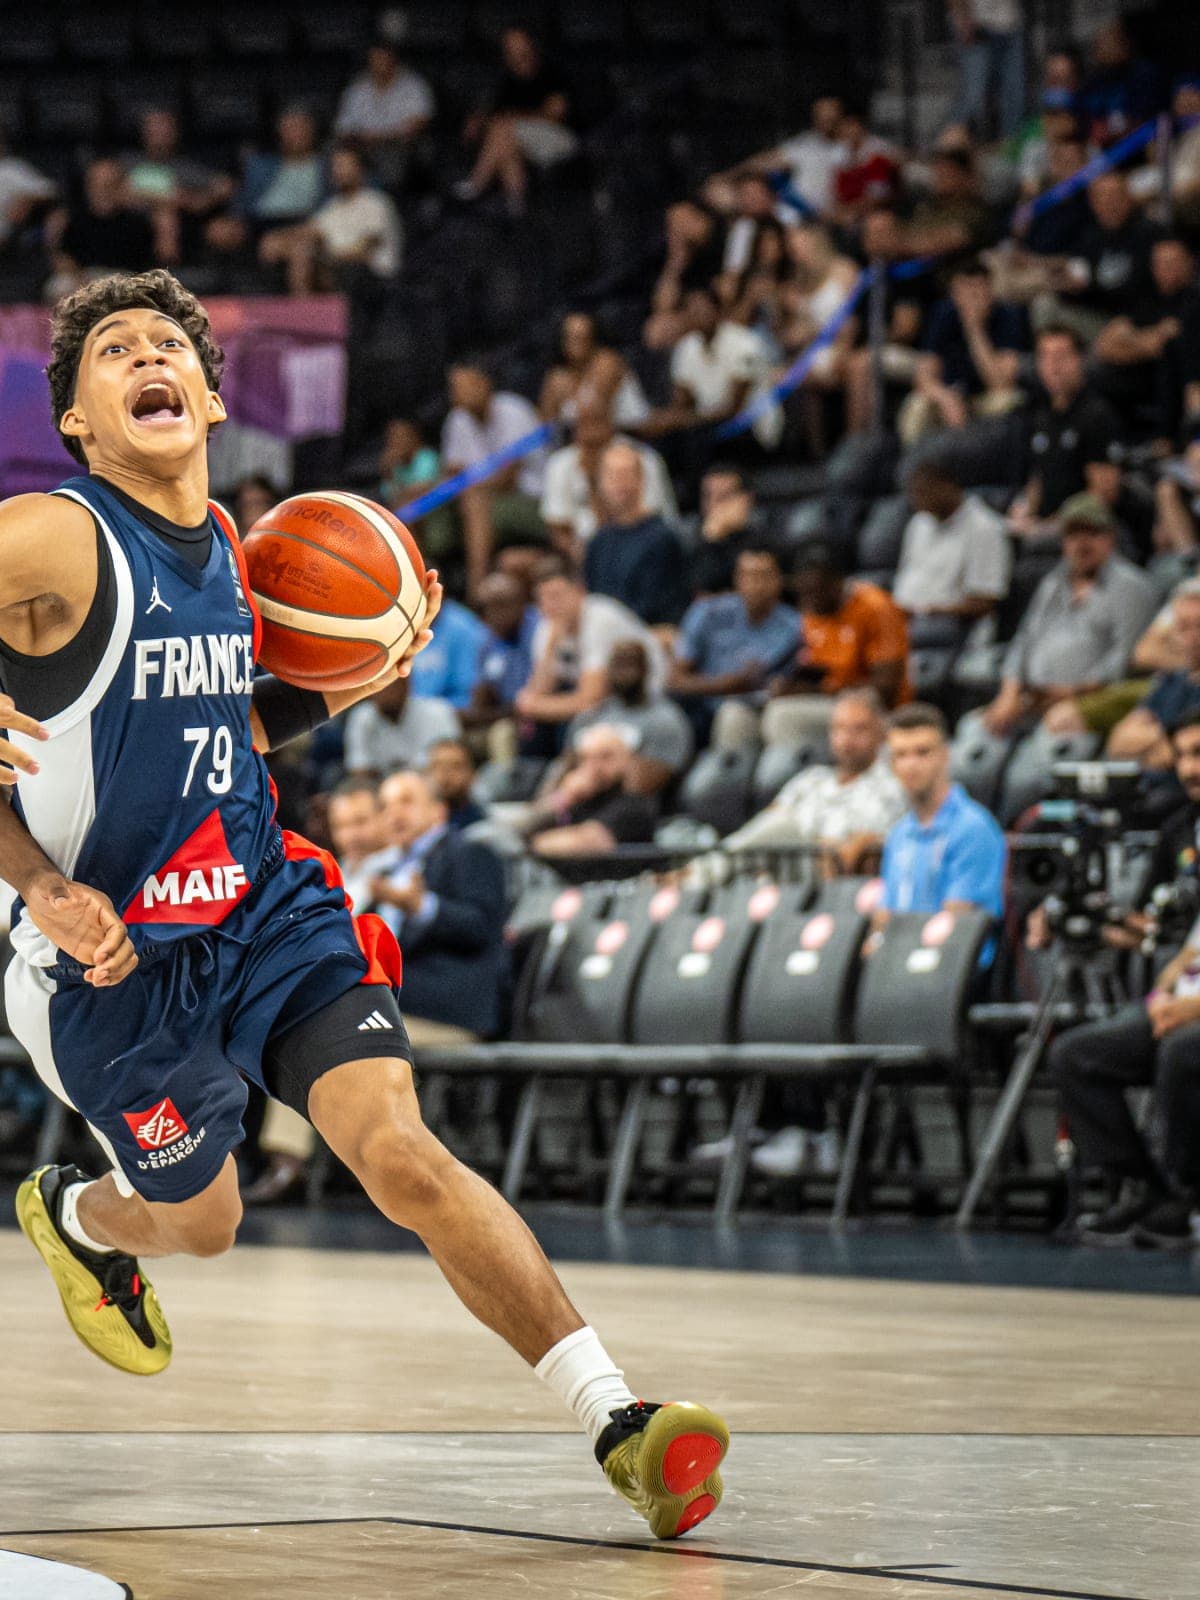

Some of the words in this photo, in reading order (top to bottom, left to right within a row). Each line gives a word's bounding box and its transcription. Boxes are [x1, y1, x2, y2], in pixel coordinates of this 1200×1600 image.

[131, 633, 254, 699] FRANCE
[182, 725, 233, 798] 79
[143, 863, 246, 908] MAIF
[136, 1126, 207, 1170] D'EPARGNE
[147, 1133, 193, 1161] CAISSE
